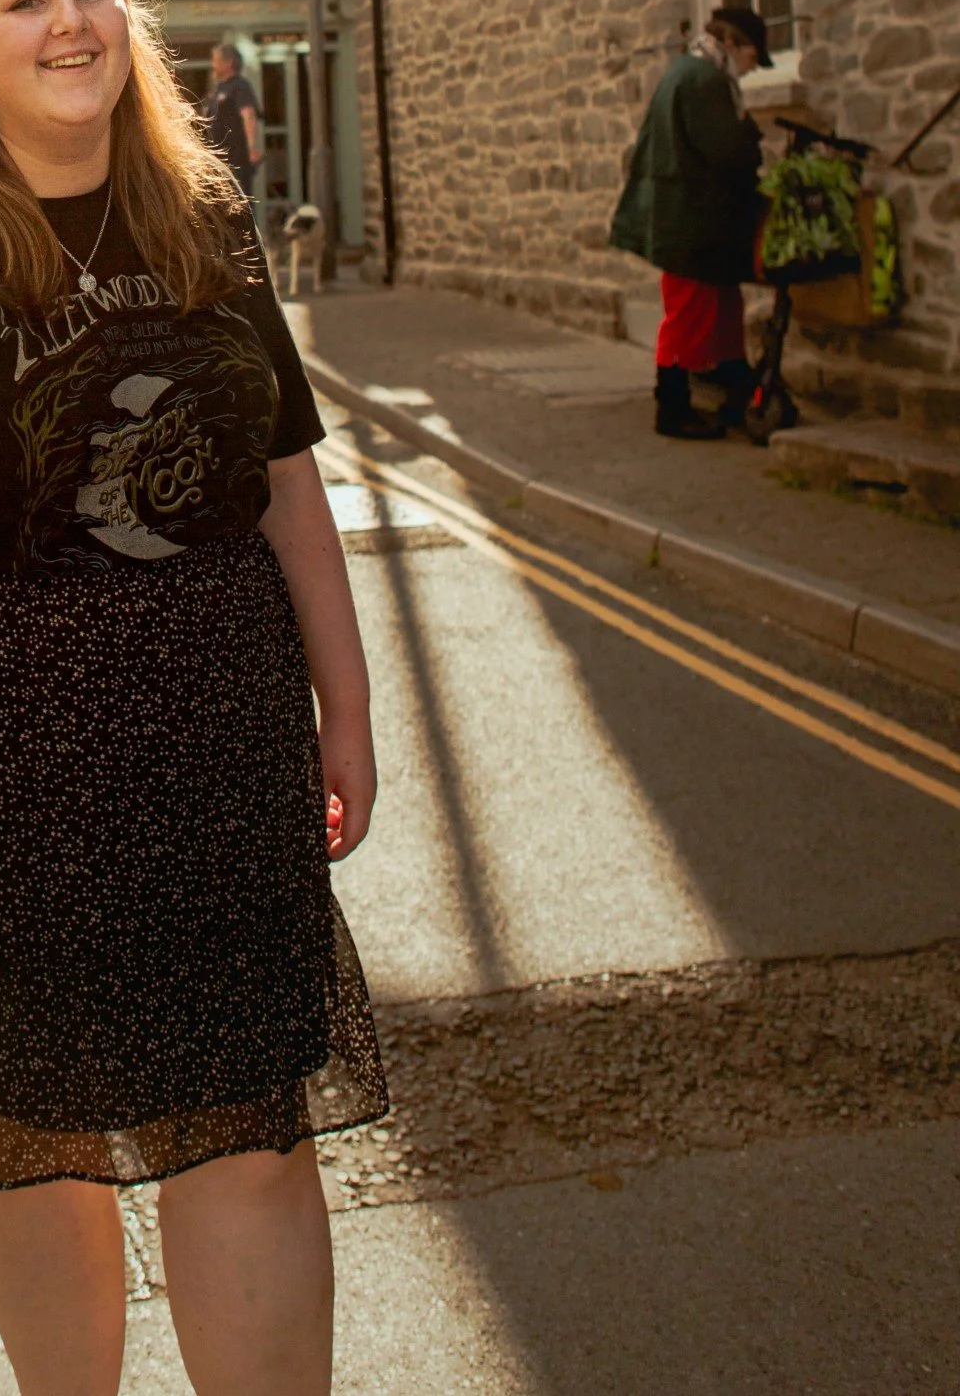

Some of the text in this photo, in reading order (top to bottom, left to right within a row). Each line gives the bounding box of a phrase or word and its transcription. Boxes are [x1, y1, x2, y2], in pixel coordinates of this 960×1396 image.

[131, 321, 174, 339] SILENCE
[120, 340, 152, 360] WALKED
[152, 340, 165, 357] IN
[163, 335, 182, 353] THE
[98, 486, 121, 506] OF
[122, 436, 221, 532] MOON
[100, 502, 131, 528] THE
